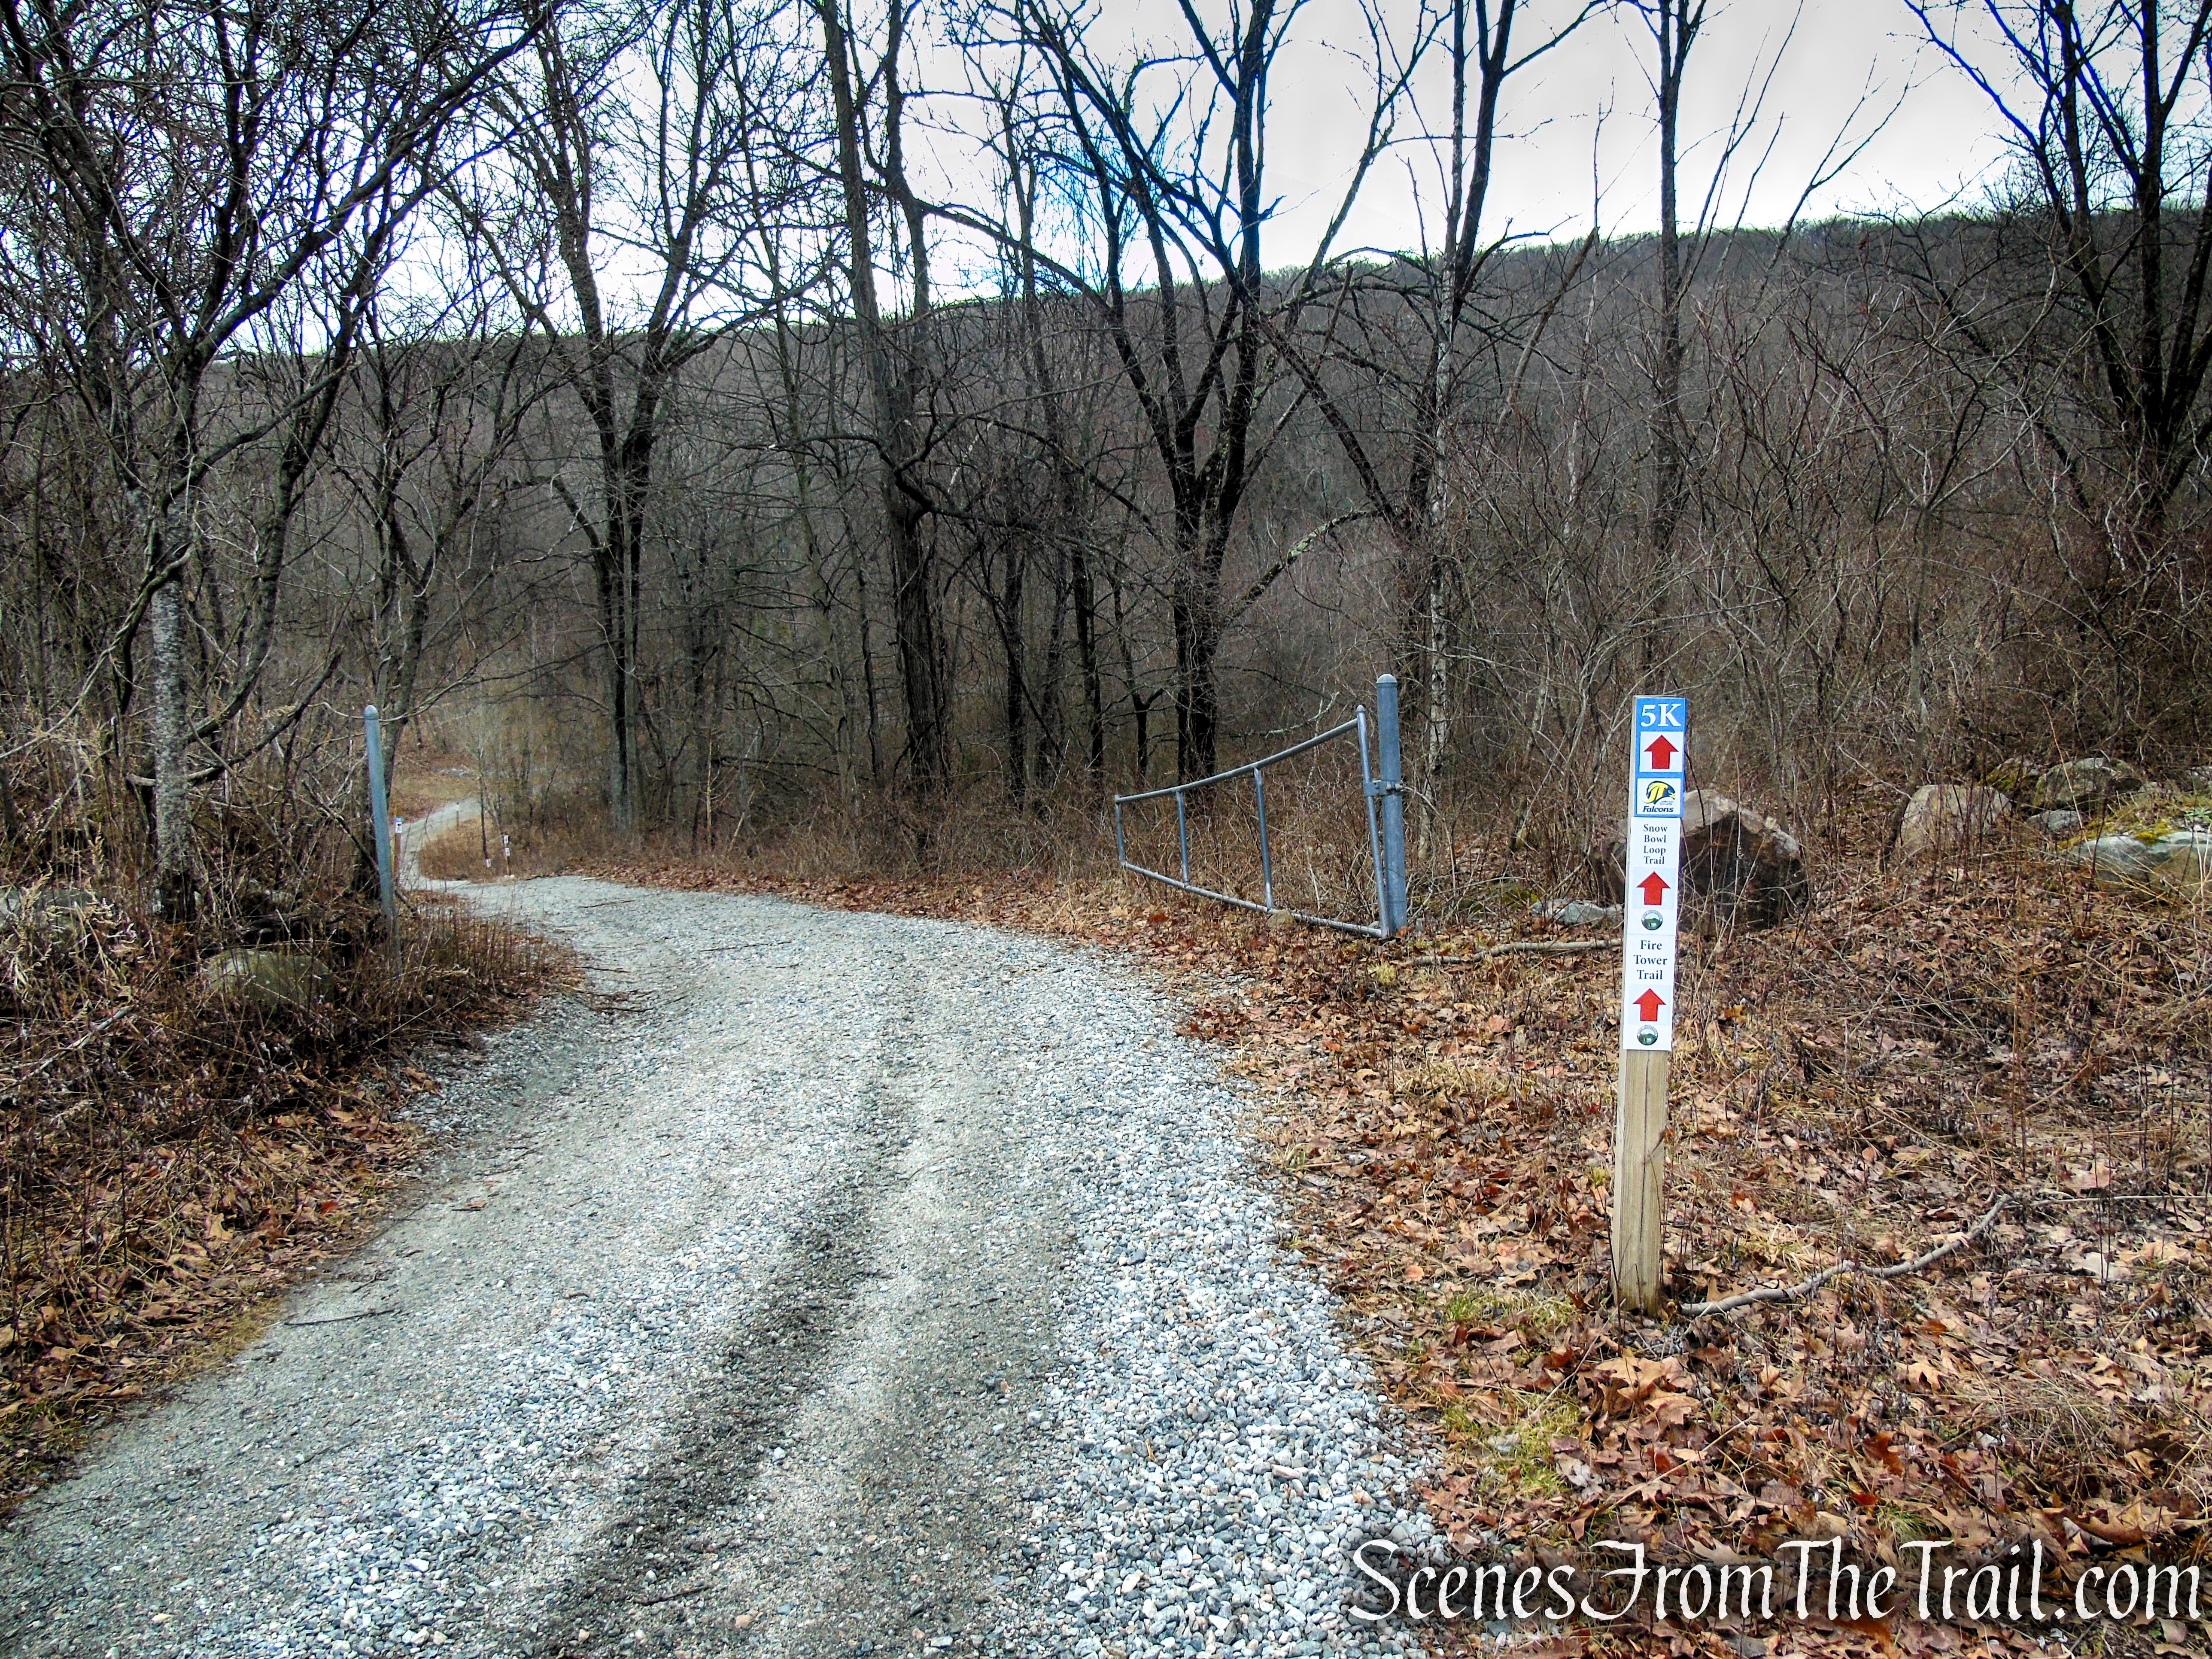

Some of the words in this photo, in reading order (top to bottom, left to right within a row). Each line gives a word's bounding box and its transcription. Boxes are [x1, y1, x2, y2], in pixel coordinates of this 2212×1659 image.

[1640, 703, 1681, 727] 5K
[1643, 823, 1668, 832] Snow
[1644, 835, 1666, 843] Bowl
[1644, 845, 1666, 856] Loop
[1643, 856, 1665, 864] Trail
[1640, 940, 1662, 950] Fire
[1633, 954, 1668, 965] Tower
[1636, 969, 1663, 980] Trail
